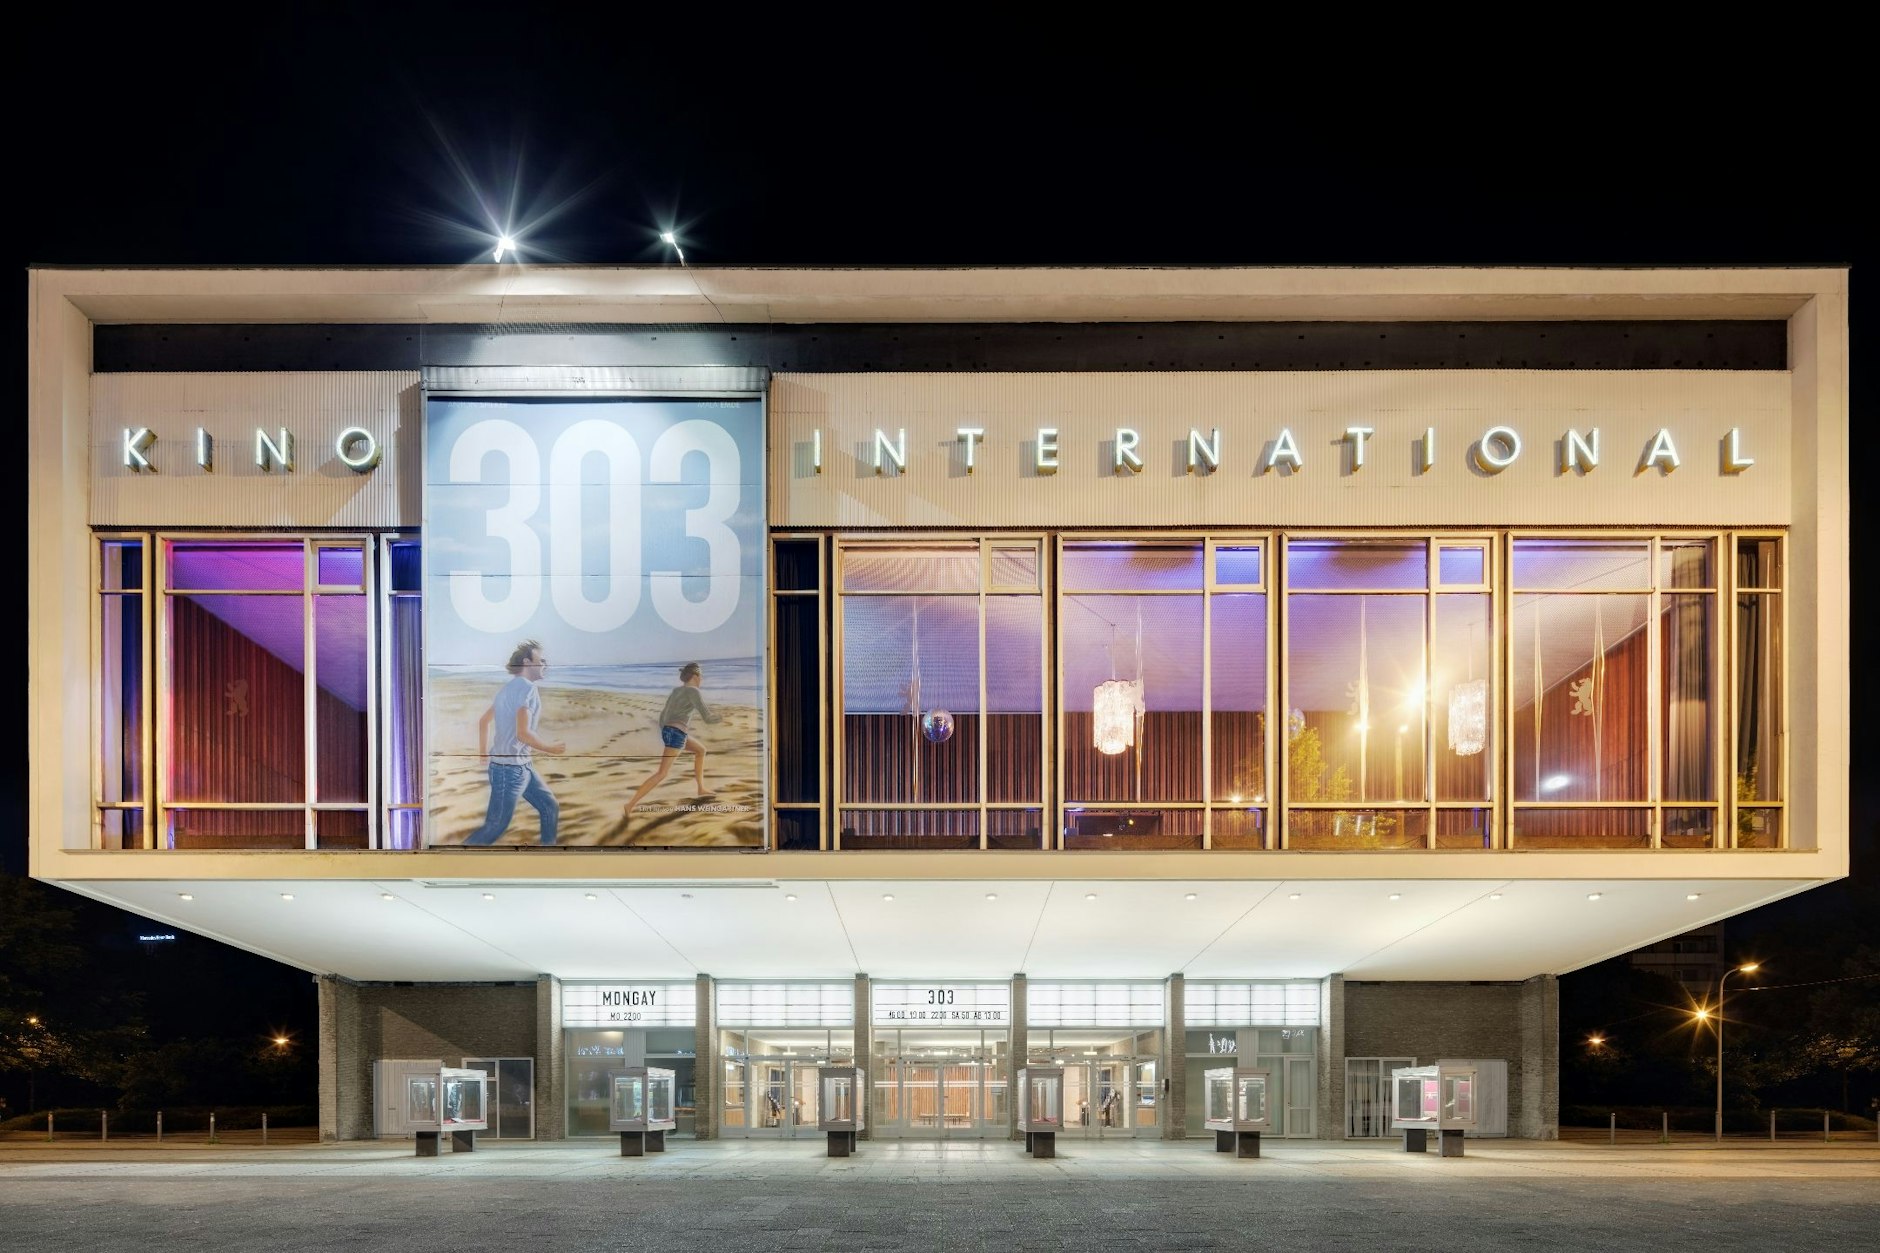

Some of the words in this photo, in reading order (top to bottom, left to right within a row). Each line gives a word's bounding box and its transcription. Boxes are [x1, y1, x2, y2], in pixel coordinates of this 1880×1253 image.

[122, 426, 382, 472] KINO
[812, 426, 1756, 476] INTERNATIONAL
[449, 418, 741, 634] 303
[602, 990, 656, 1006] MONGAY
[928, 989, 954, 1005] 303
